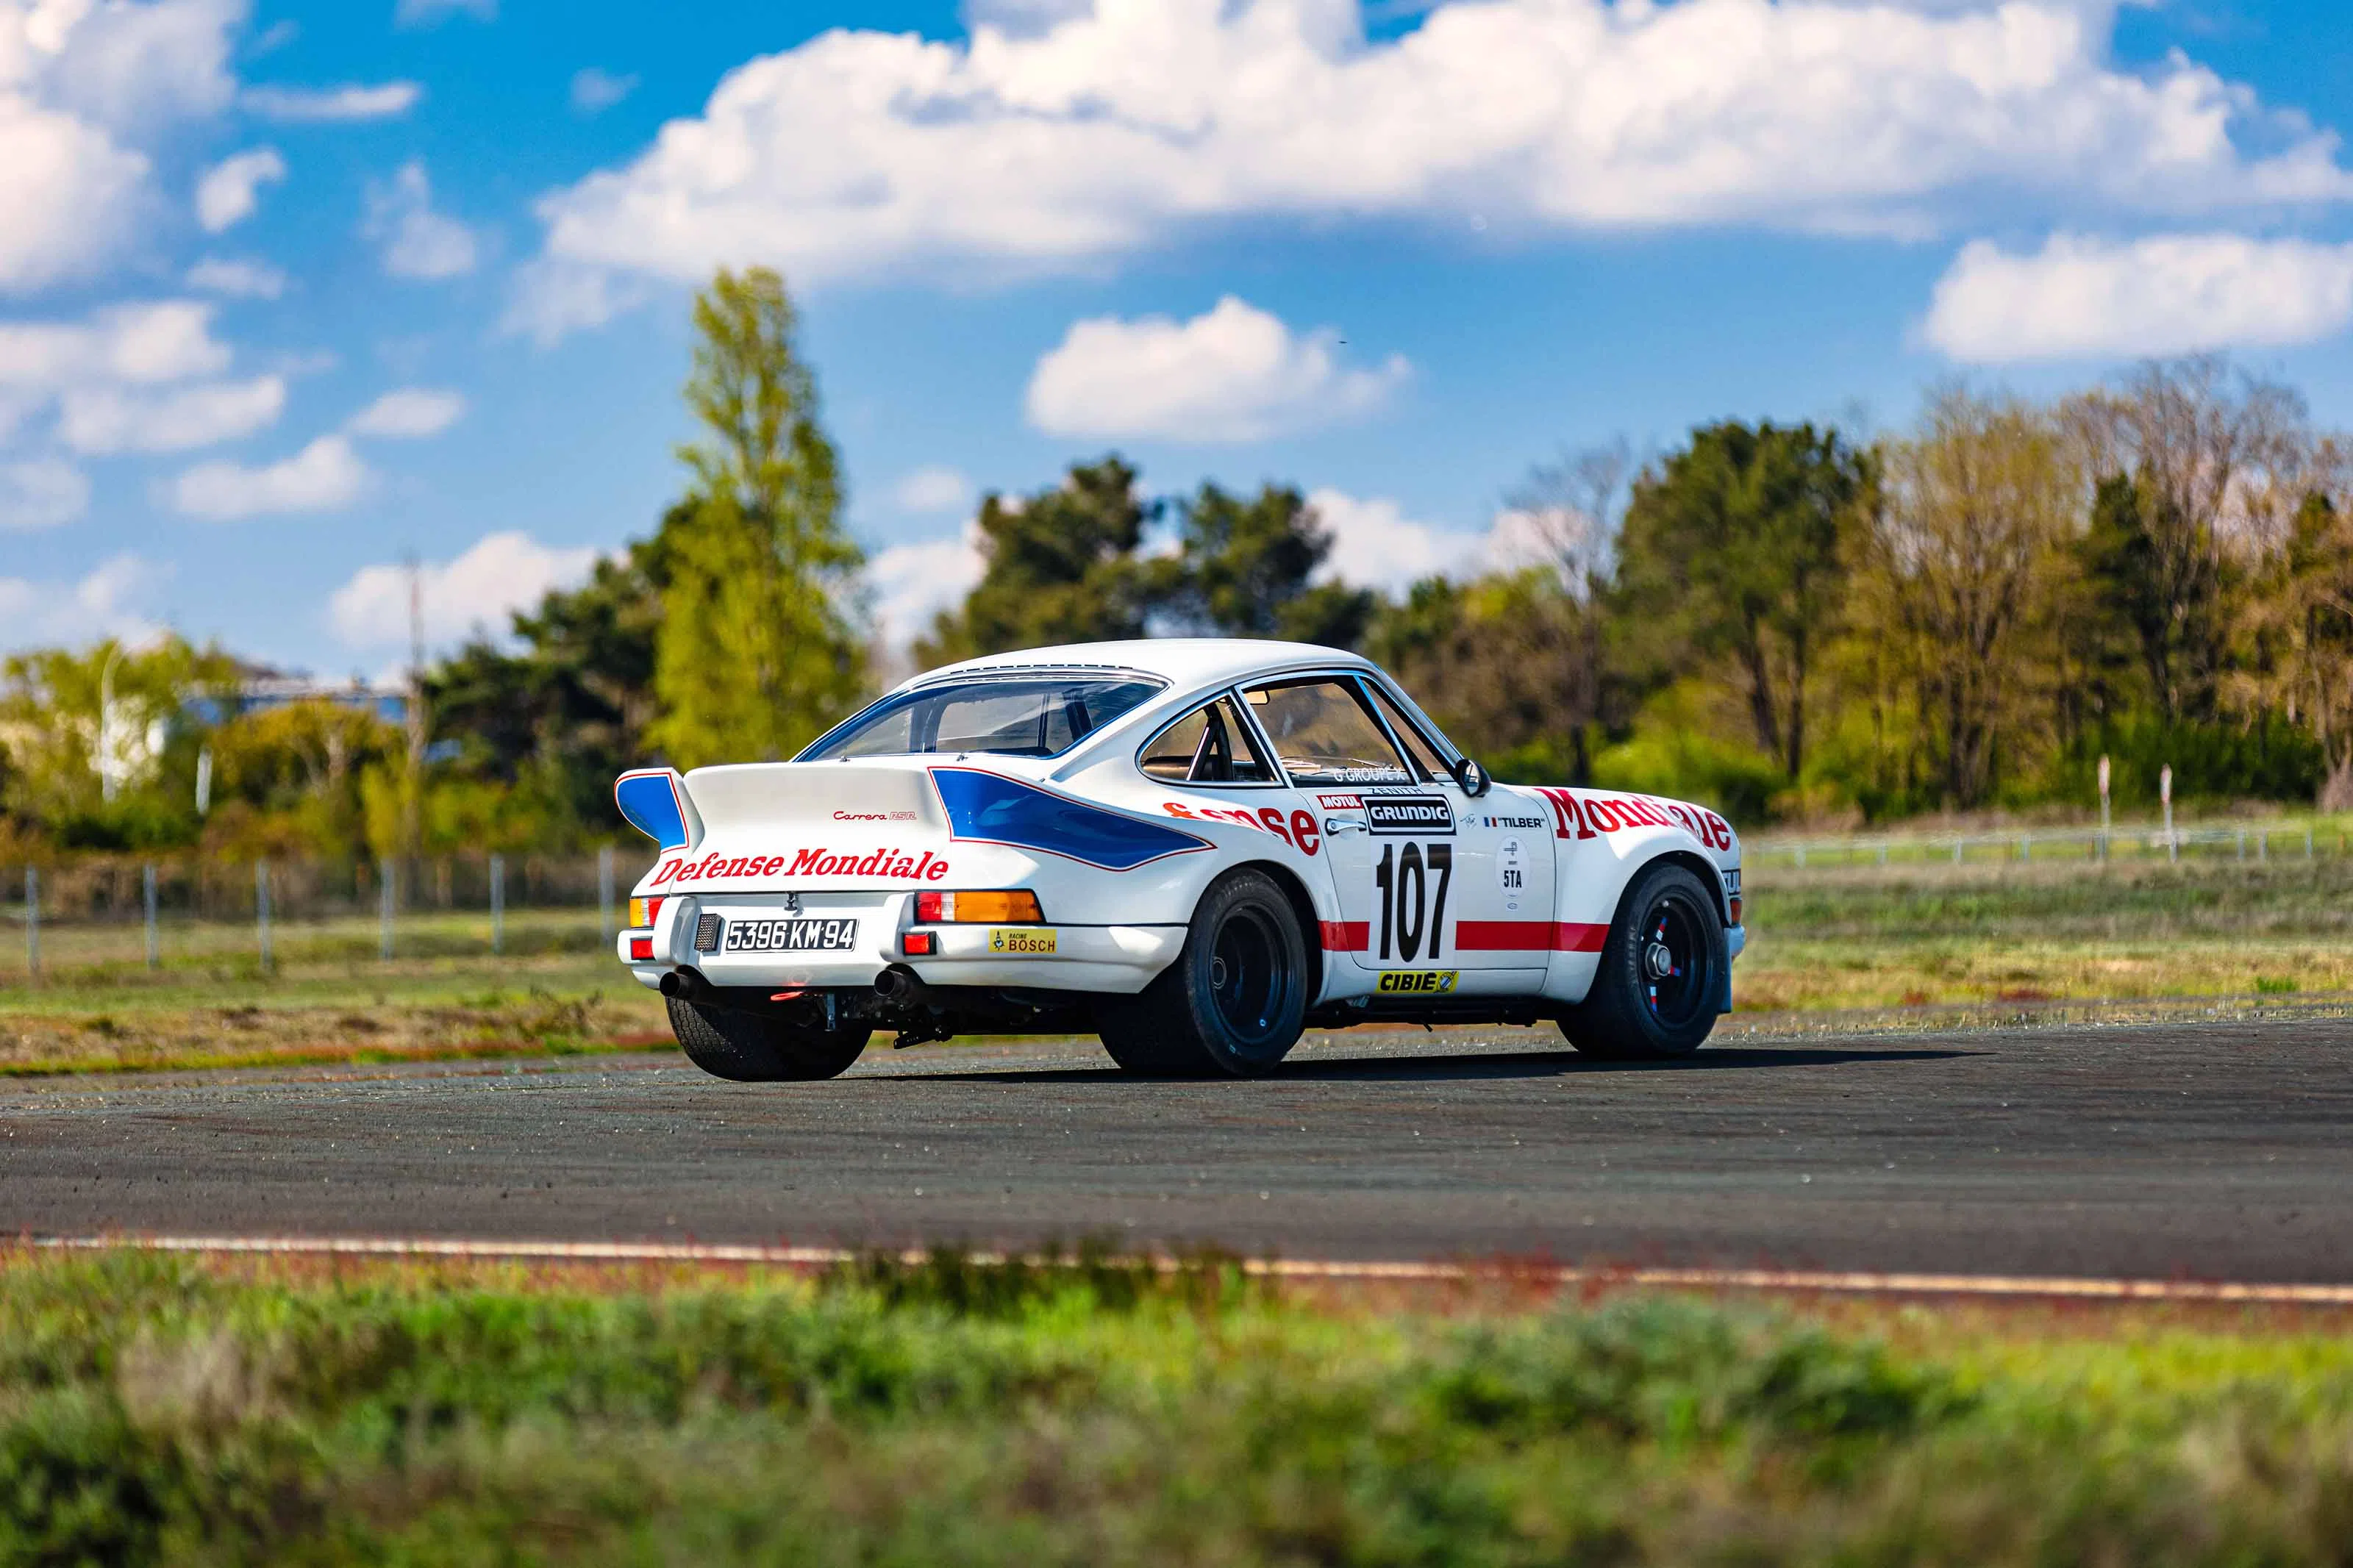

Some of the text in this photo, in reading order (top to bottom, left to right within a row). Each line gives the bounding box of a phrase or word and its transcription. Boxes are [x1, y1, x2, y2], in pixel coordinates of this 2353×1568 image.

[1322, 796, 1360, 808] MOTUL
[833, 811, 917, 820] Carrera RSR
[1371, 806, 1449, 820] GRUNDIG
[1532, 788, 1730, 851] Mondiale
[650, 848, 949, 886] Defense Mondiale
[1504, 870, 1522, 888] 5TA
[1377, 842, 1452, 962] 107
[727, 920, 854, 950] 5396 KM 94
[1009, 939, 1054, 951] BOSCH
